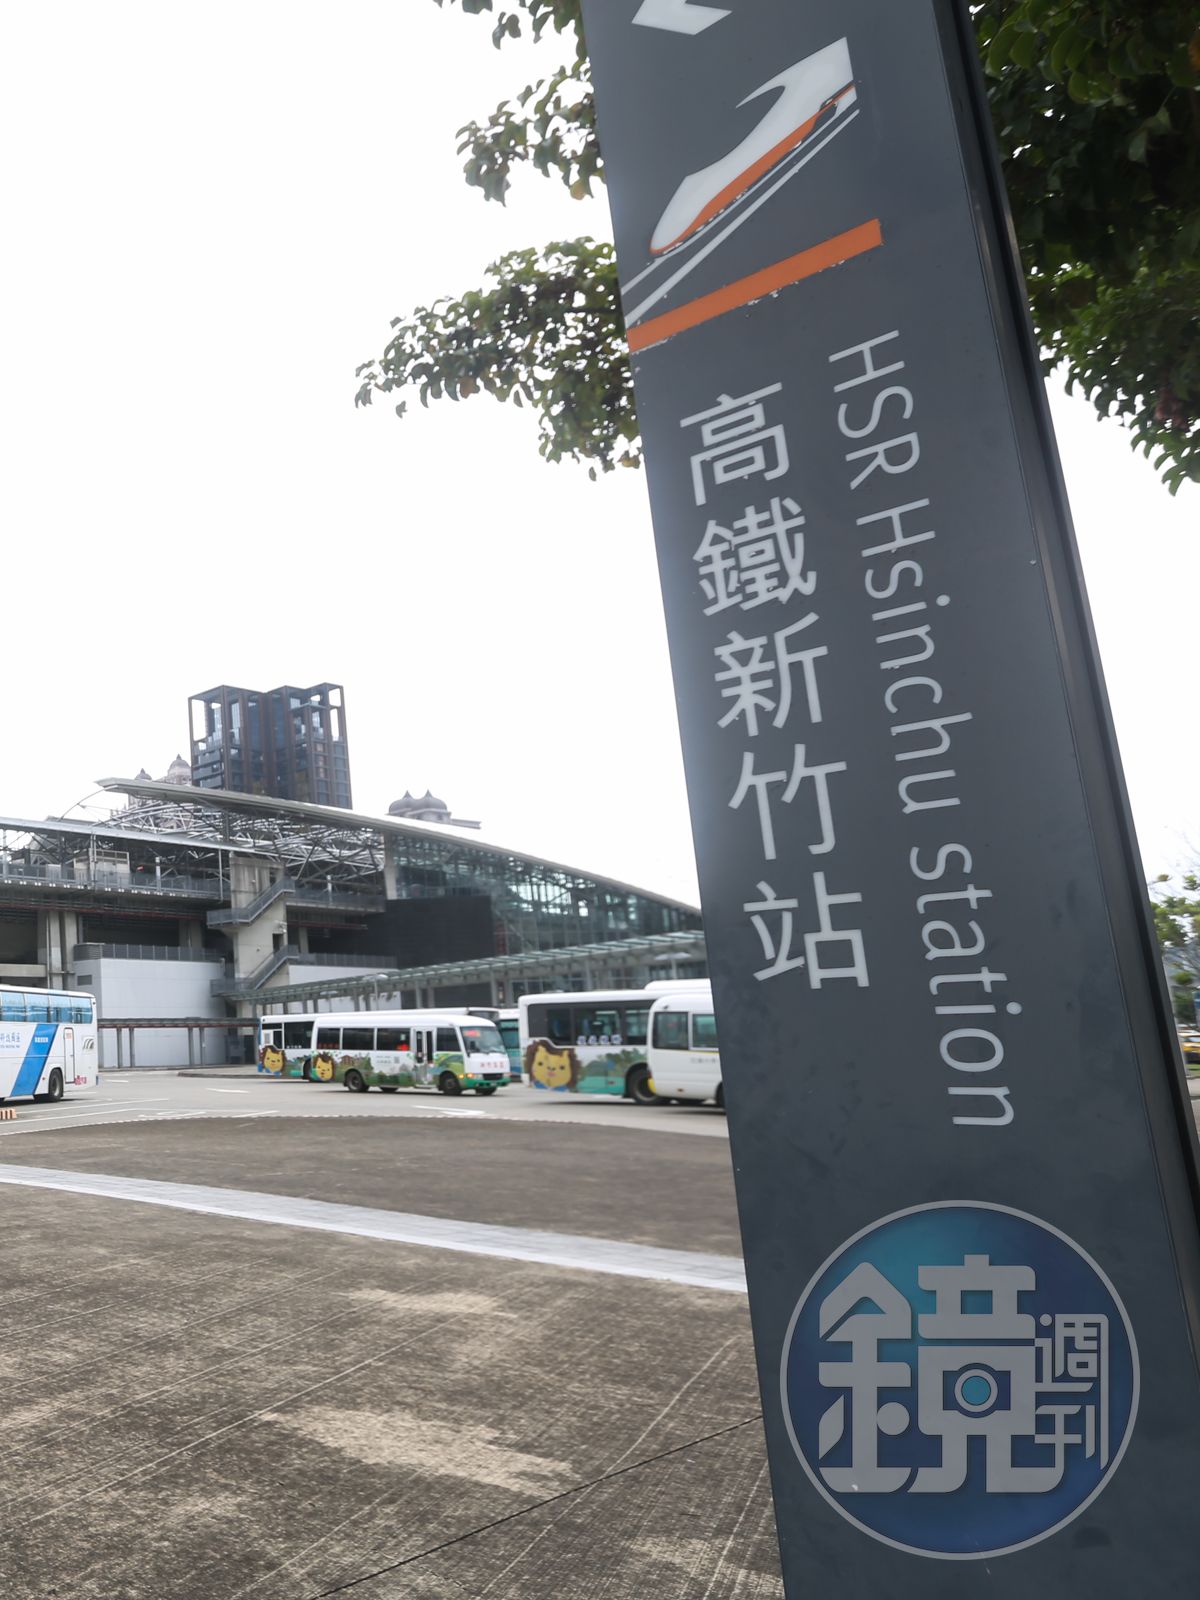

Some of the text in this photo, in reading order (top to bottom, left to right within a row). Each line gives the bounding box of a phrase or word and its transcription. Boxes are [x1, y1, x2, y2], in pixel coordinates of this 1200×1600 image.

[679, 382, 869, 989] 高鐵新竹站
[828, 330, 1022, 1127] HSR Hsinchu station
